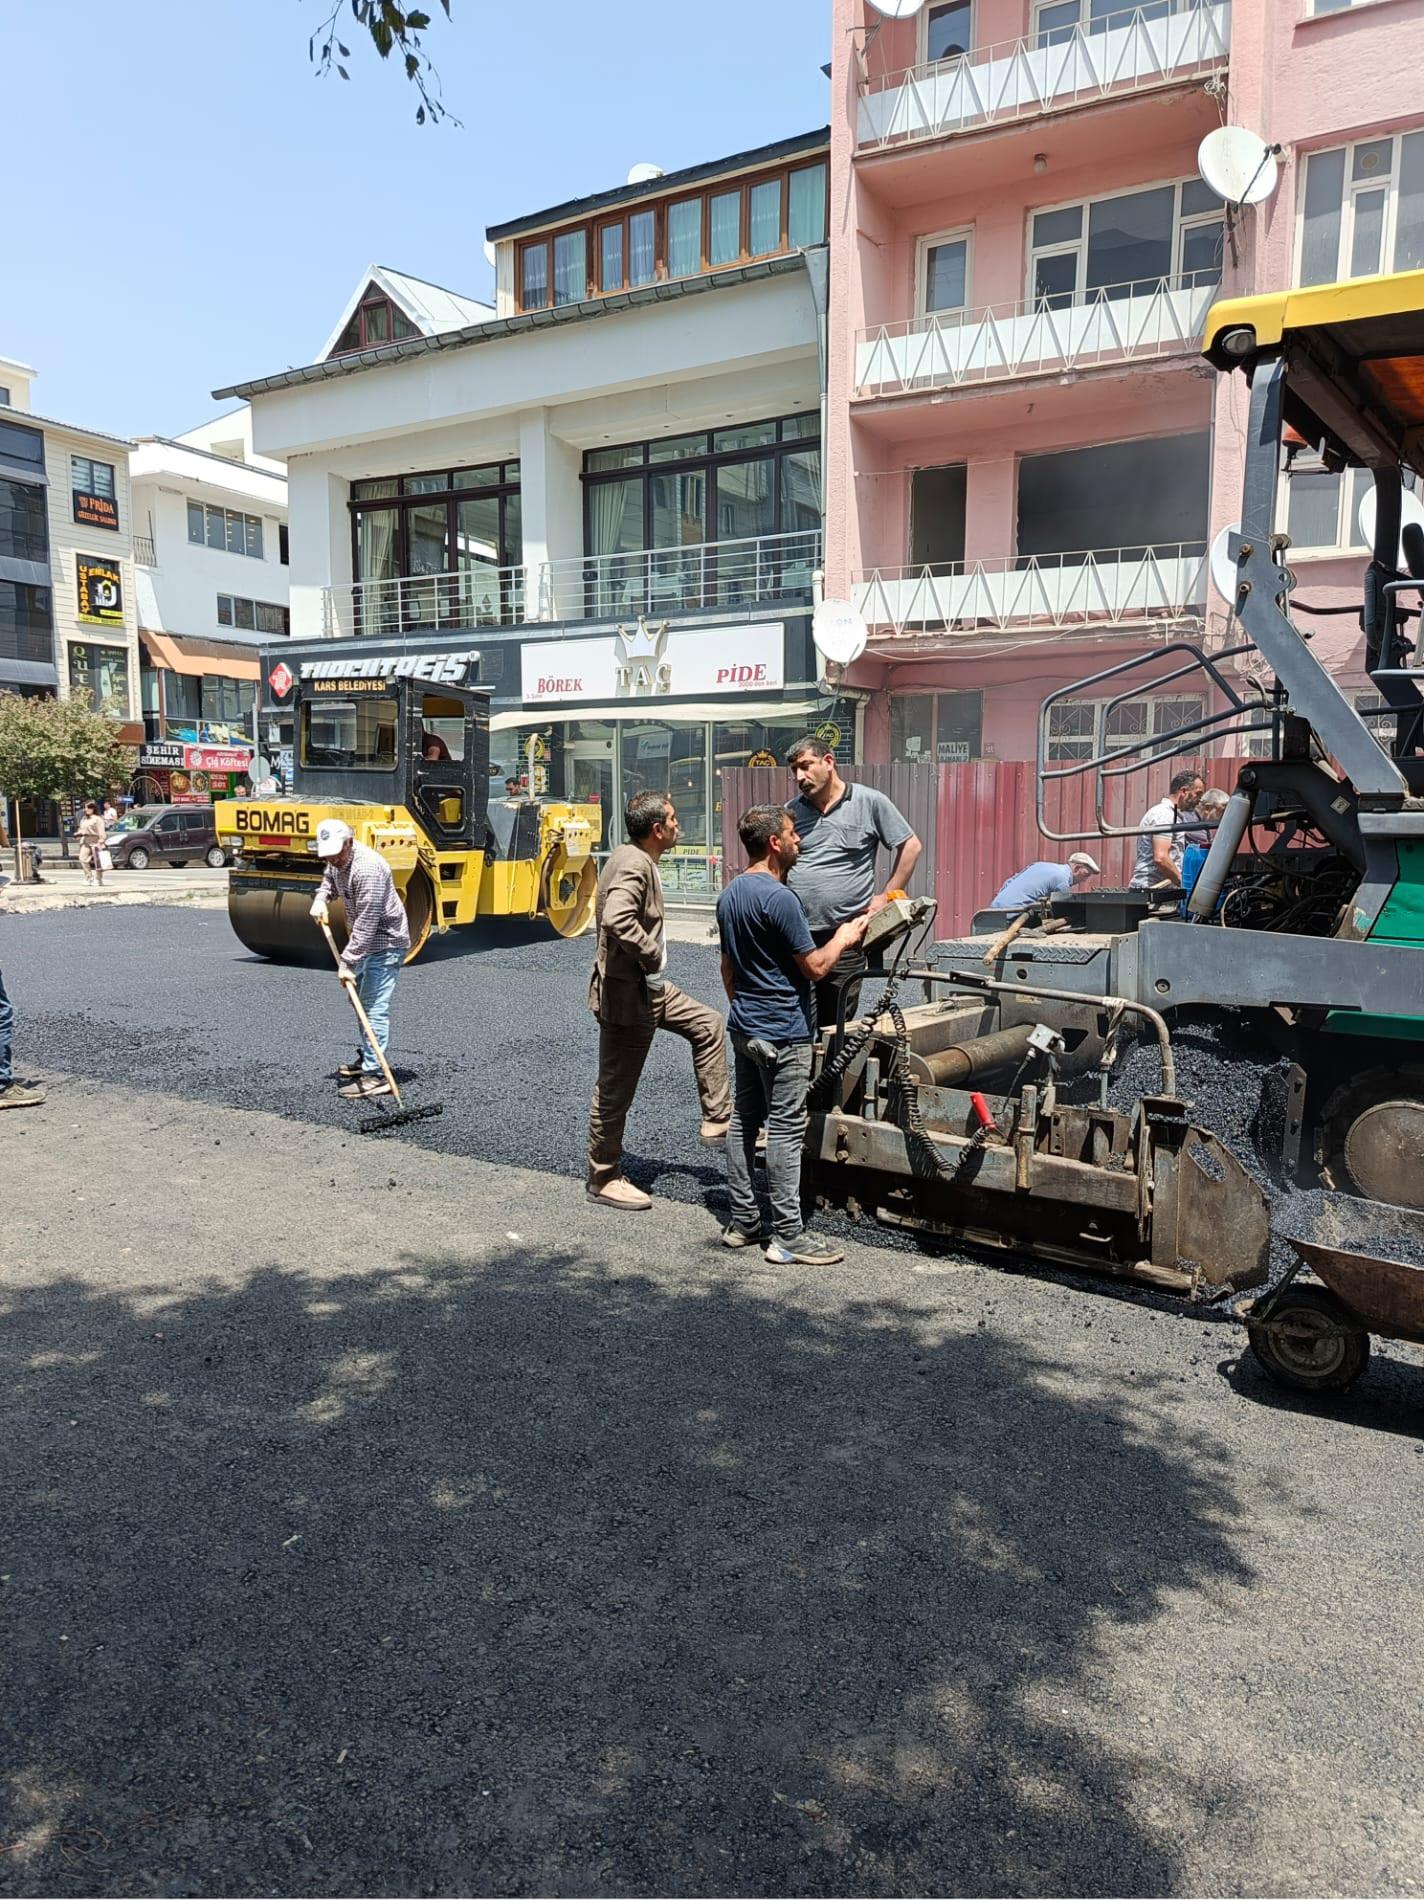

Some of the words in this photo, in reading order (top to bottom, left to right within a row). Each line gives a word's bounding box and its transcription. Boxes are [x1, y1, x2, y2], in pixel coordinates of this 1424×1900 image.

[615, 664, 672, 692] TAÇ
[716, 664, 767, 683] PİDE
[314, 680, 336, 691] KARS
[537, 675, 583, 693] BÖREK
[146, 745, 179, 756] ŞEHİR
[938, 743, 968, 754] MALİYE
[141, 755, 184, 766] SİNEMASI
[206, 757, 219, 768] Çiğ
[220, 757, 249, 767] Köftesi
[236, 810, 310, 834] BOMAG
